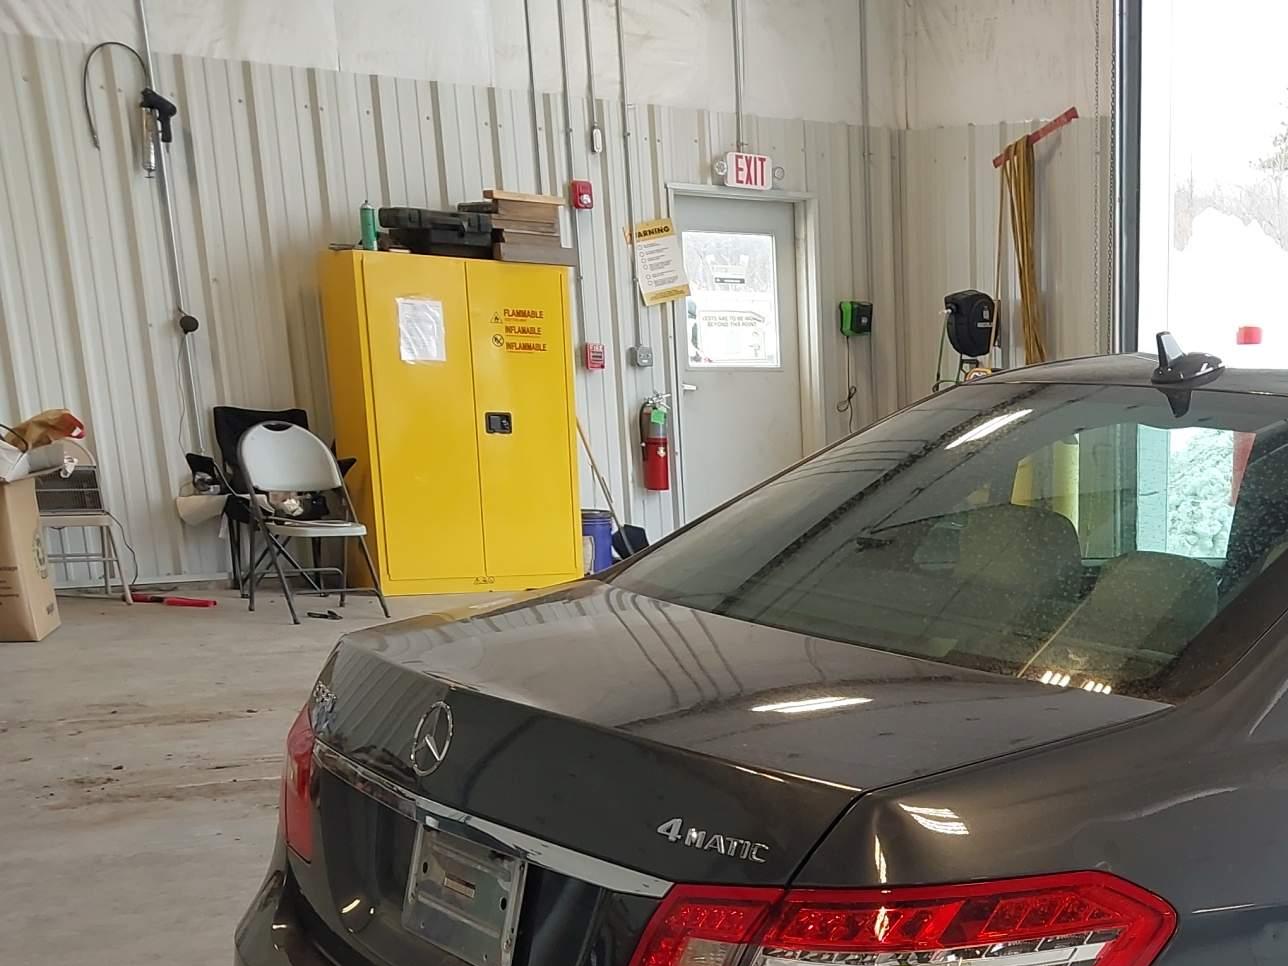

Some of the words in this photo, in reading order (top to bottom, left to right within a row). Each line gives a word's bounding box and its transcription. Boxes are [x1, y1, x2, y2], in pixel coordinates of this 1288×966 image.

[735, 154, 766, 187] EXIT
[634, 225, 671, 239] ARNING
[503, 308, 544, 319] FLAMMABLE
[506, 342, 548, 352] INFLAMMABLE
